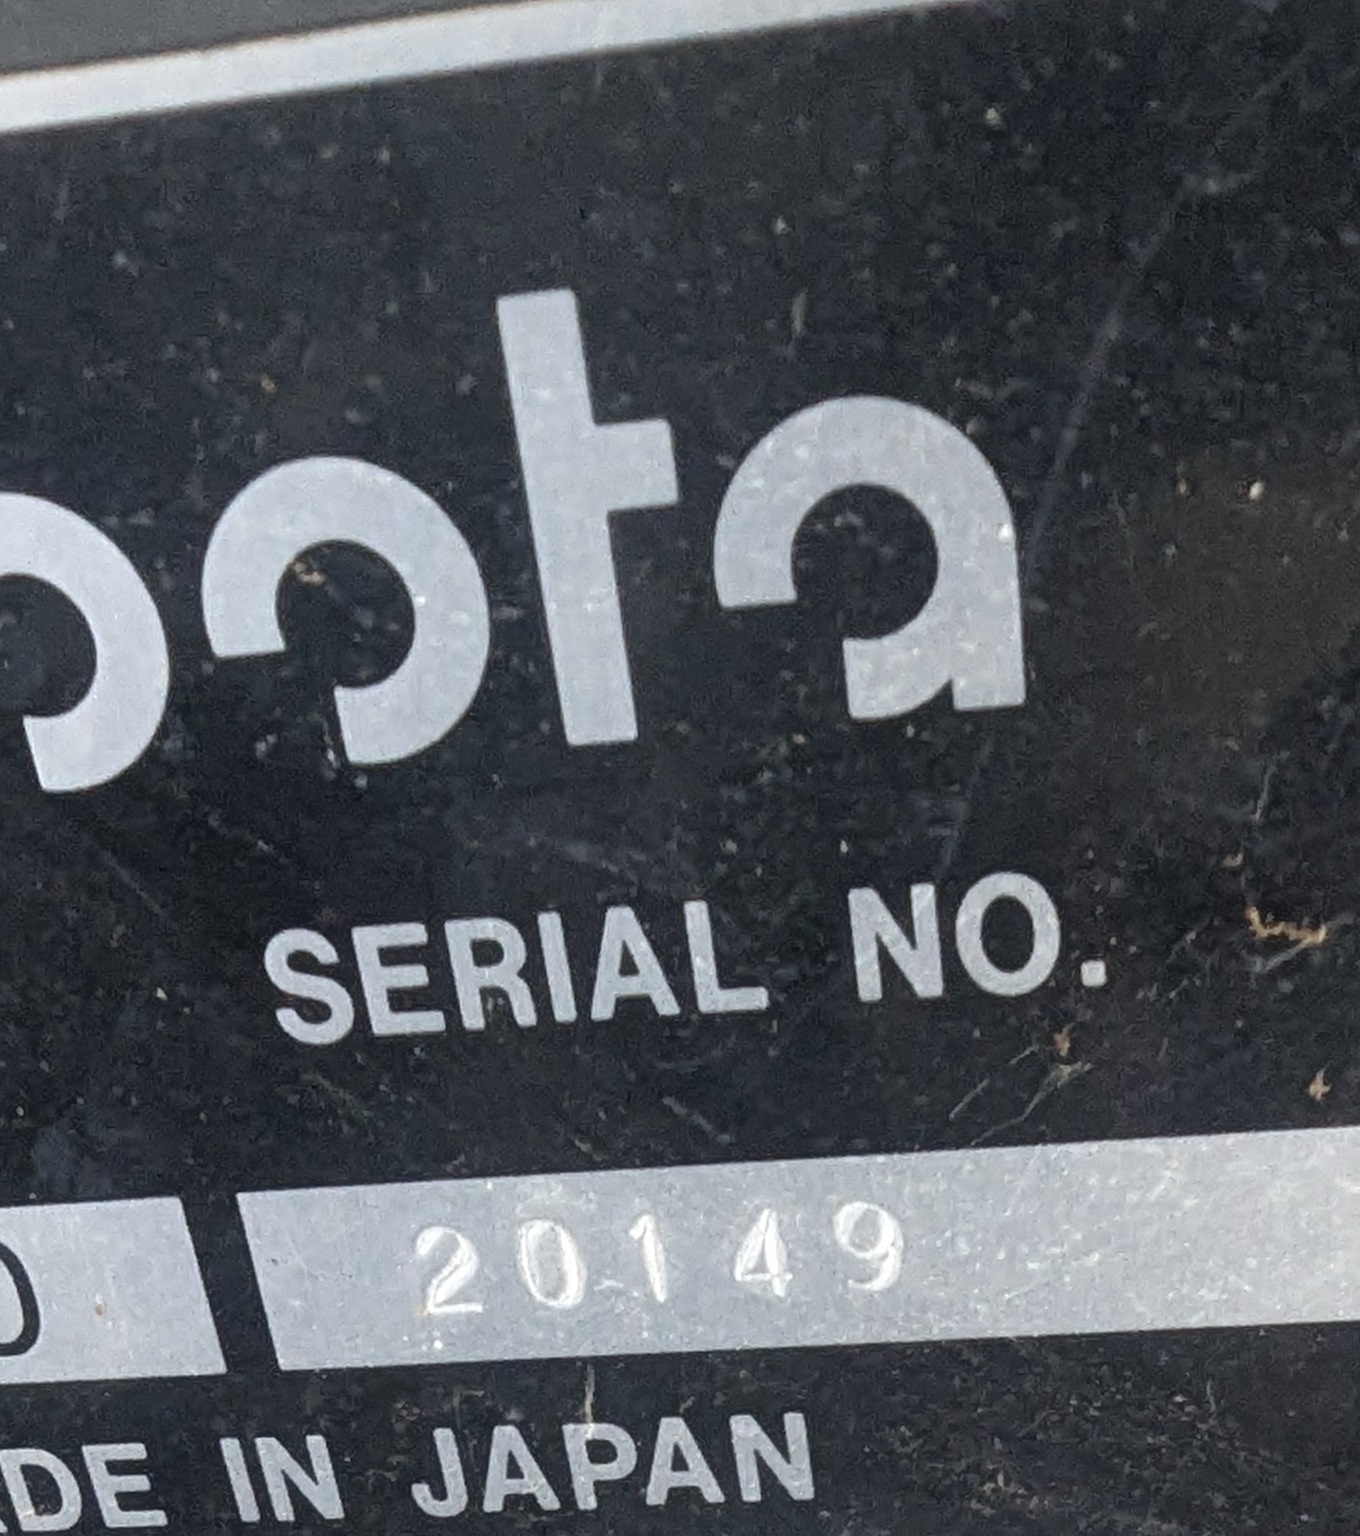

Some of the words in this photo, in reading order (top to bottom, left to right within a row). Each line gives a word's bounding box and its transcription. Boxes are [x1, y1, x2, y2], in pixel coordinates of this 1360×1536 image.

[264, 897, 770, 1046] SERIAL
[849, 871, 1108, 1005] NO.
[412, 1200, 905, 1316] 20149
[221, 1433, 344, 1525] IN
[409, 1411, 817, 1521] JAPAN
